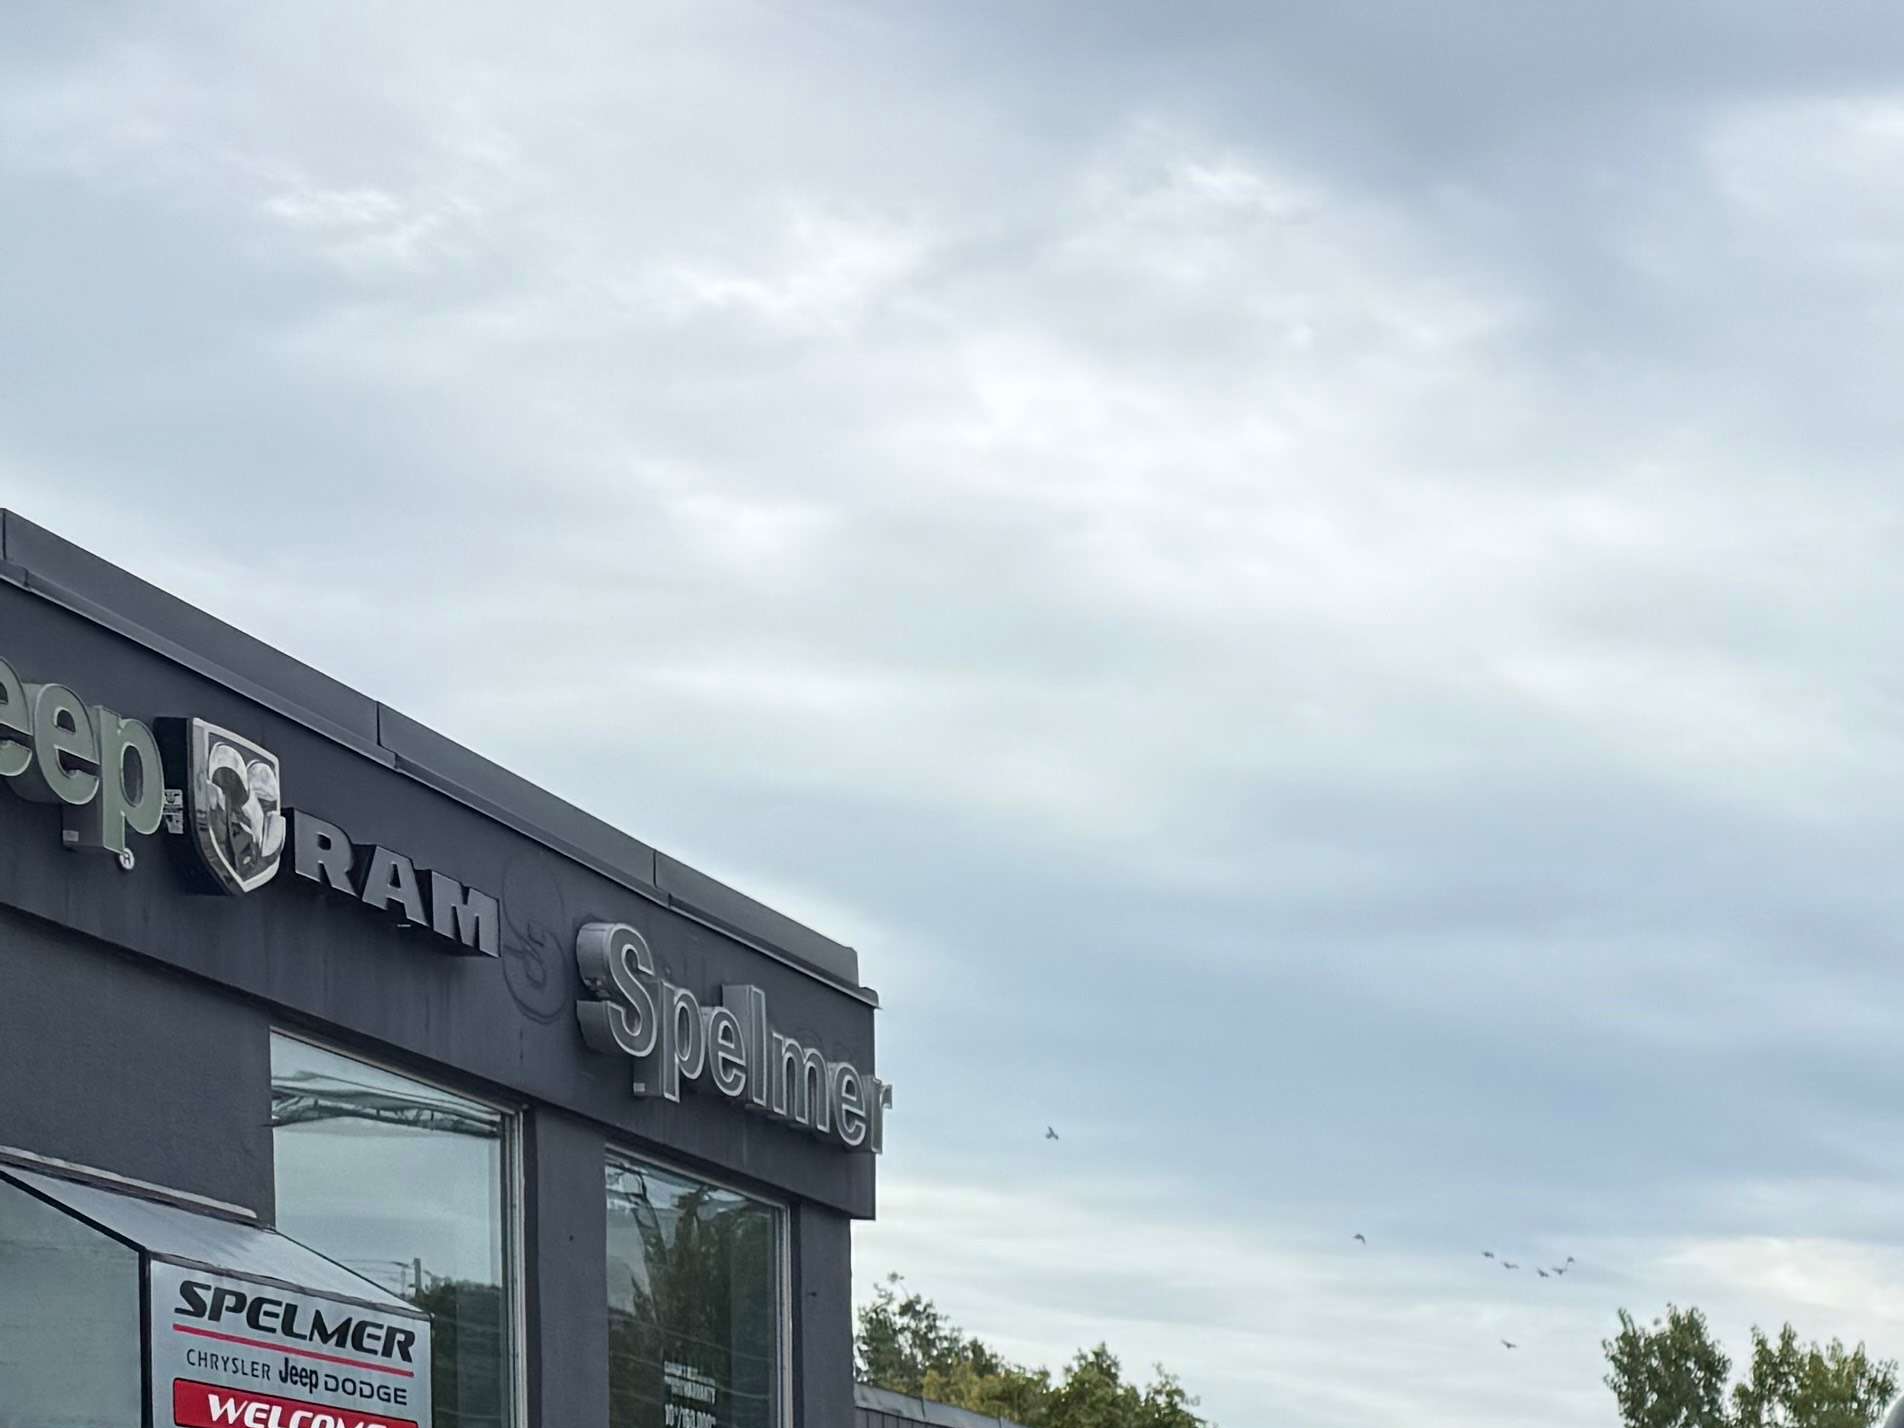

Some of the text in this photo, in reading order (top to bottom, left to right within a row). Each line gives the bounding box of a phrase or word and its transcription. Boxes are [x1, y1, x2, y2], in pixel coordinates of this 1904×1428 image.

[290, 808, 501, 958] RAM
[577, 922, 893, 1154] Spelmer
[174, 1280, 415, 1363] SPELMER
[187, 1348, 407, 1406] CHRYSLER Jeep DODGE
